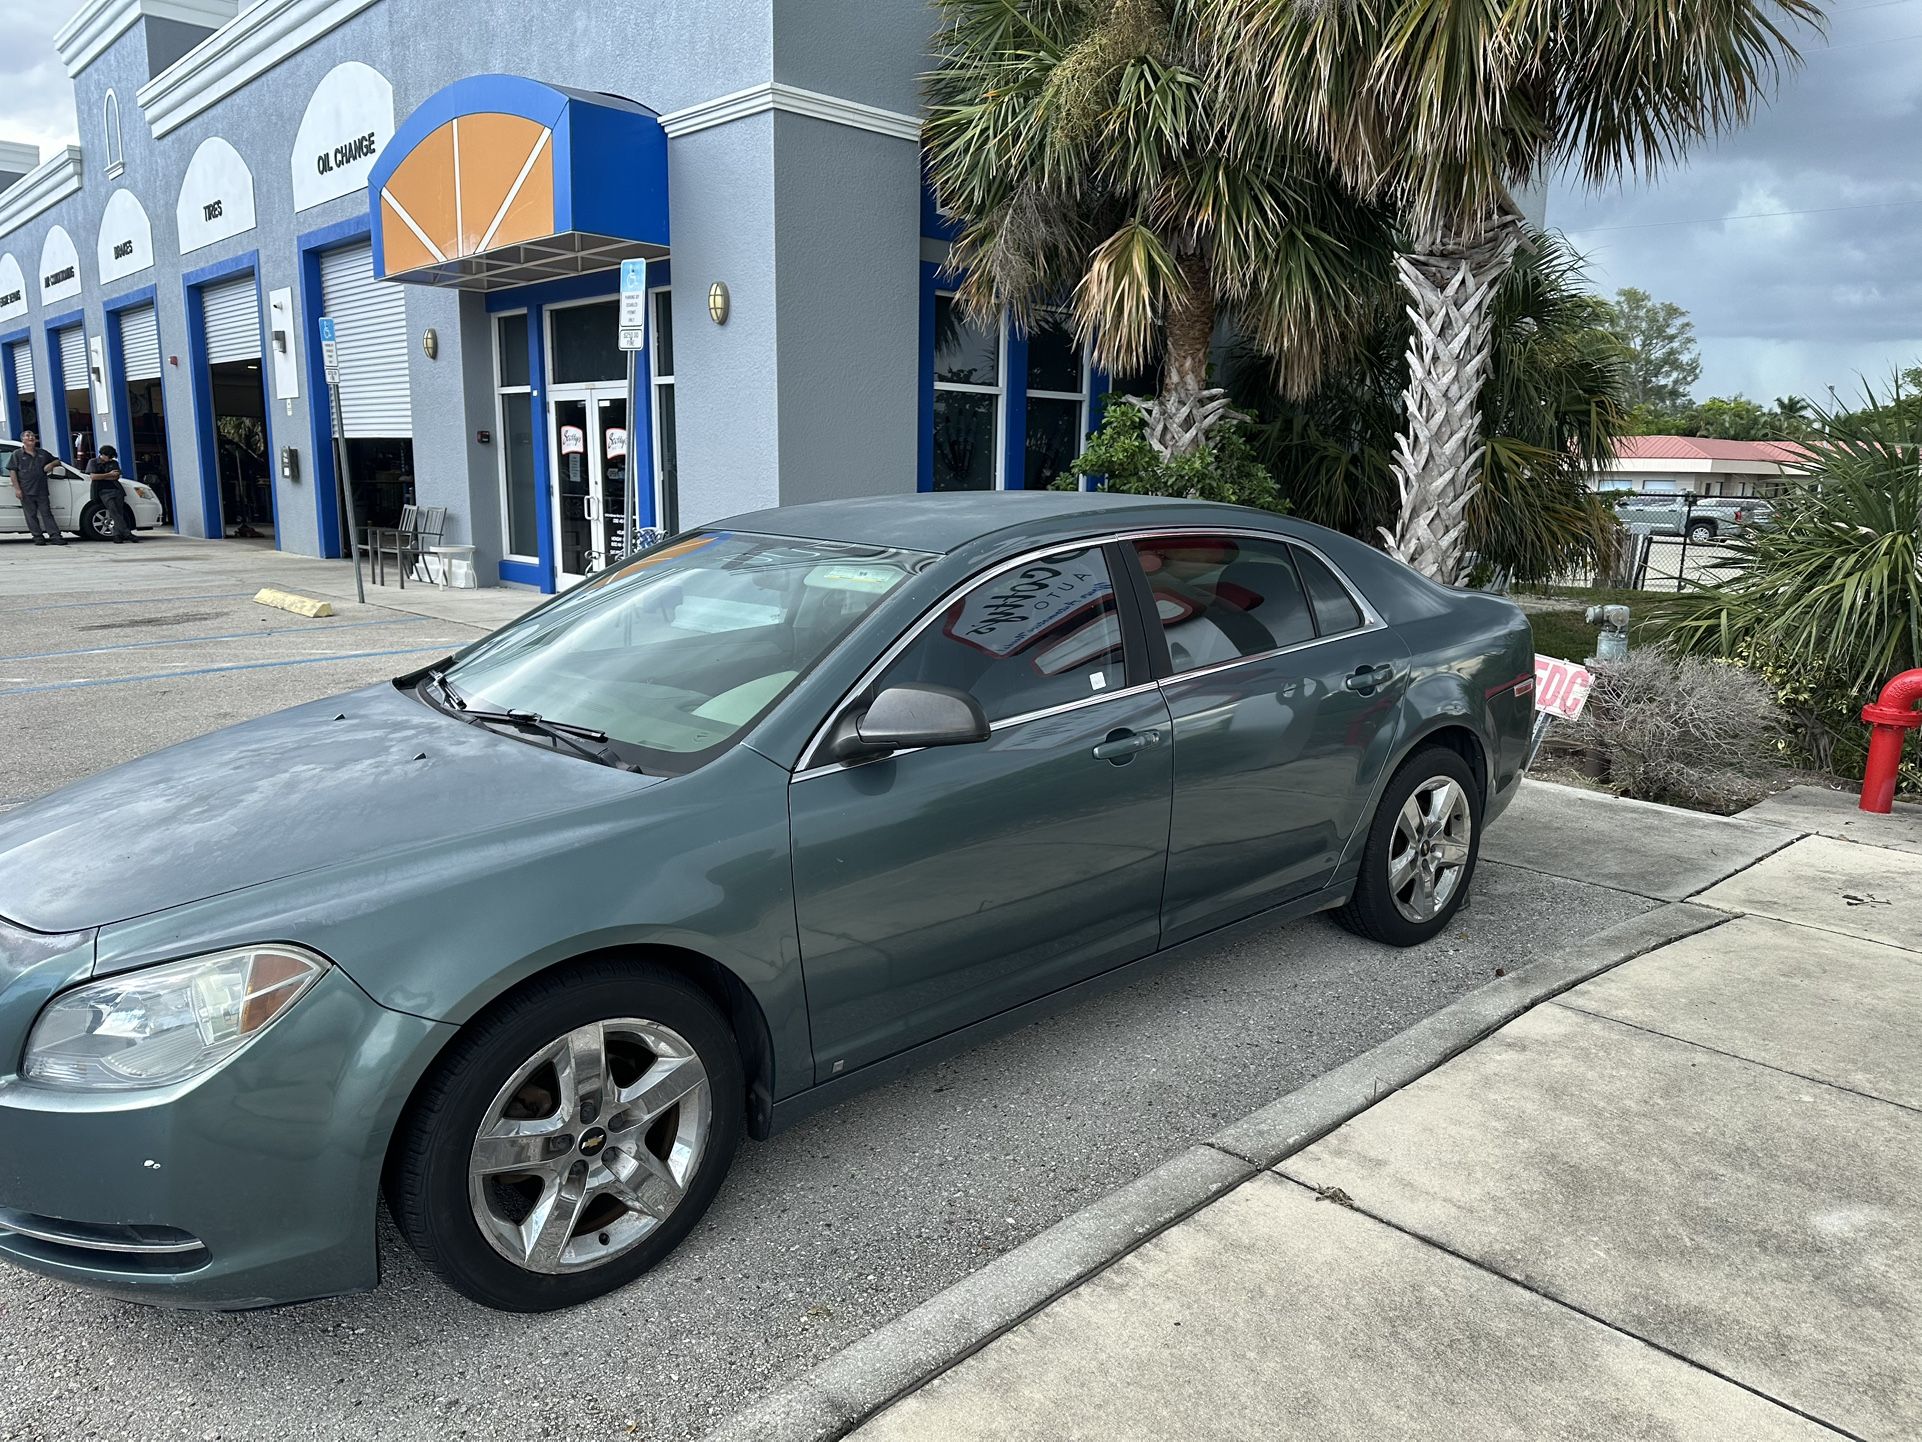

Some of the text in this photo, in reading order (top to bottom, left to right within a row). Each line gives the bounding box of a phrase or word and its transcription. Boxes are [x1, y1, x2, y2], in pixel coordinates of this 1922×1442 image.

[317, 131, 376, 175] OIL CHANGE
[203, 200, 222, 222] TIRES
